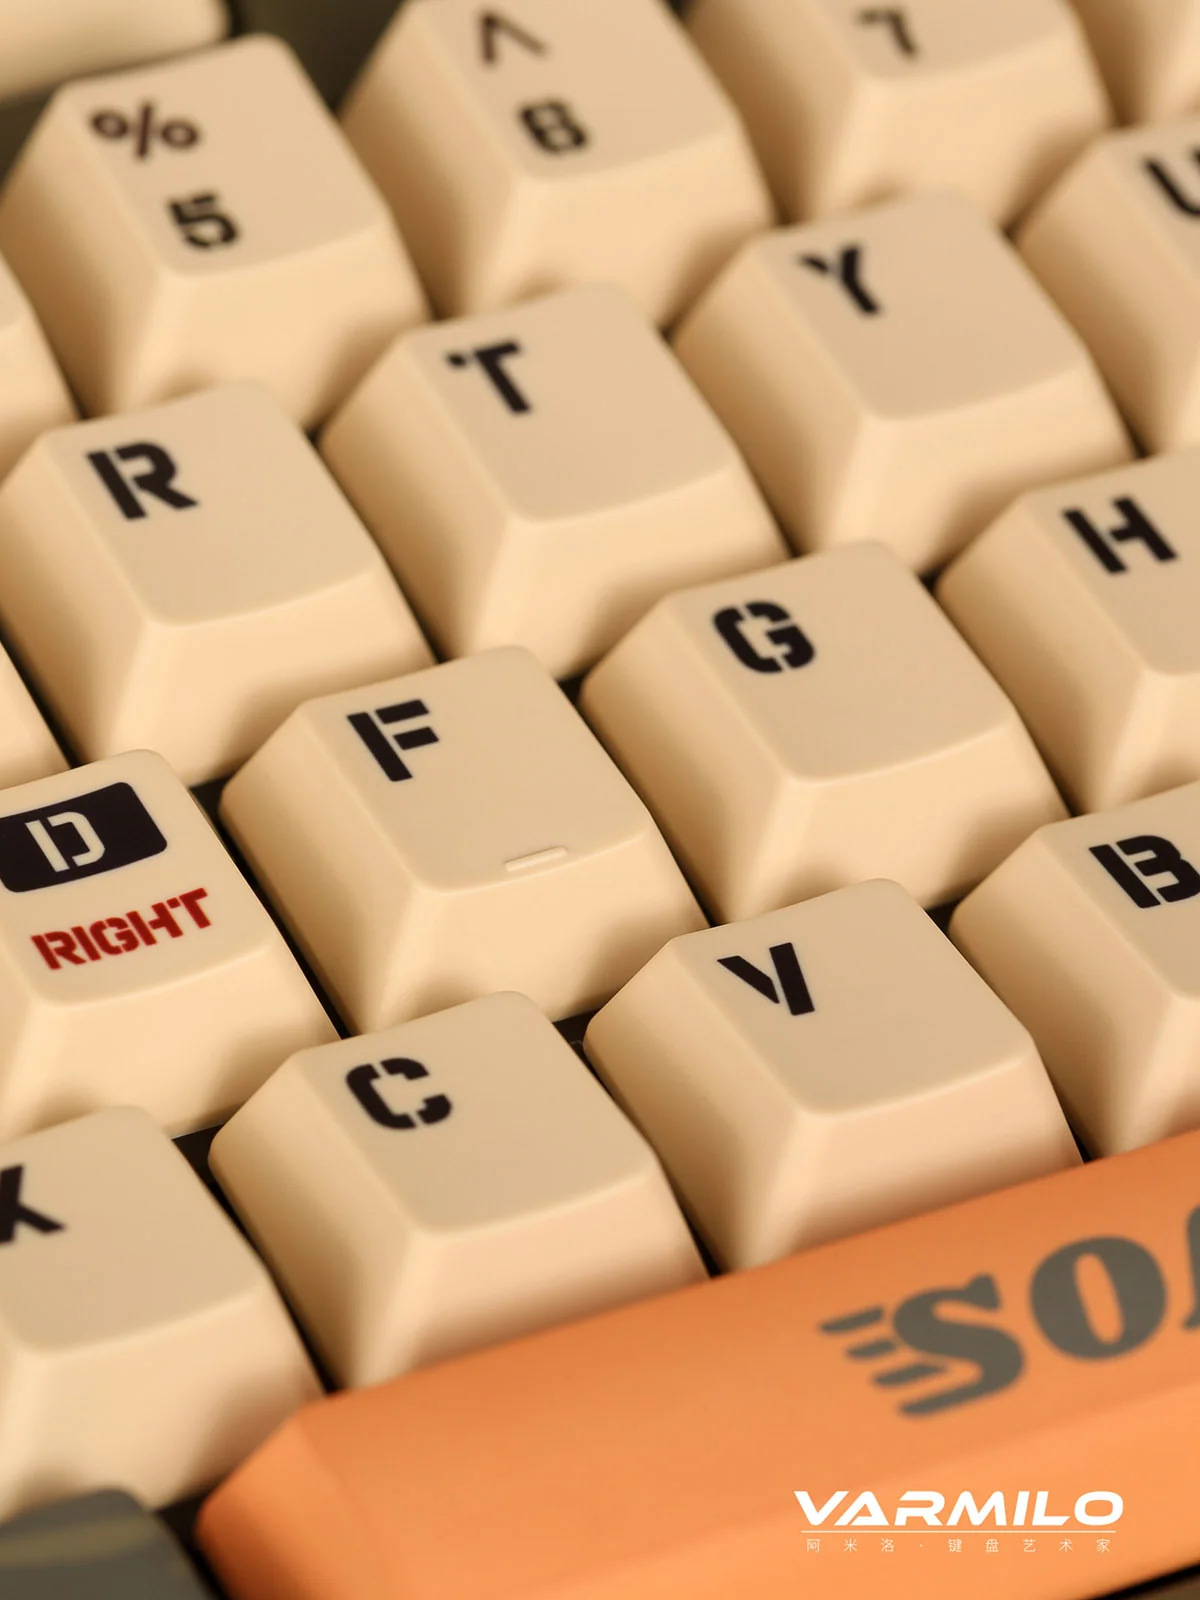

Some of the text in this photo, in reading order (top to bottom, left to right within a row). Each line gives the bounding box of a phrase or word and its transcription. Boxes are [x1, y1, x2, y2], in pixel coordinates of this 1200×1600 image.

[89, 102, 200, 160] %
[168, 193, 239, 250] 5
[802, 245, 879, 316] Y
[447, 341, 531, 414] T
[86, 442, 197, 520] R
[1063, 497, 1177, 574] H
[713, 601, 815, 674] G
[347, 699, 439, 782] F
[24, 811, 106, 873] D
[1089, 835, 1200, 908] B
[30, 887, 211, 970] RIGHT
[717, 942, 815, 1016] V
[345, 1058, 452, 1130] C
[818, 1203, 1200, 1418] SO
